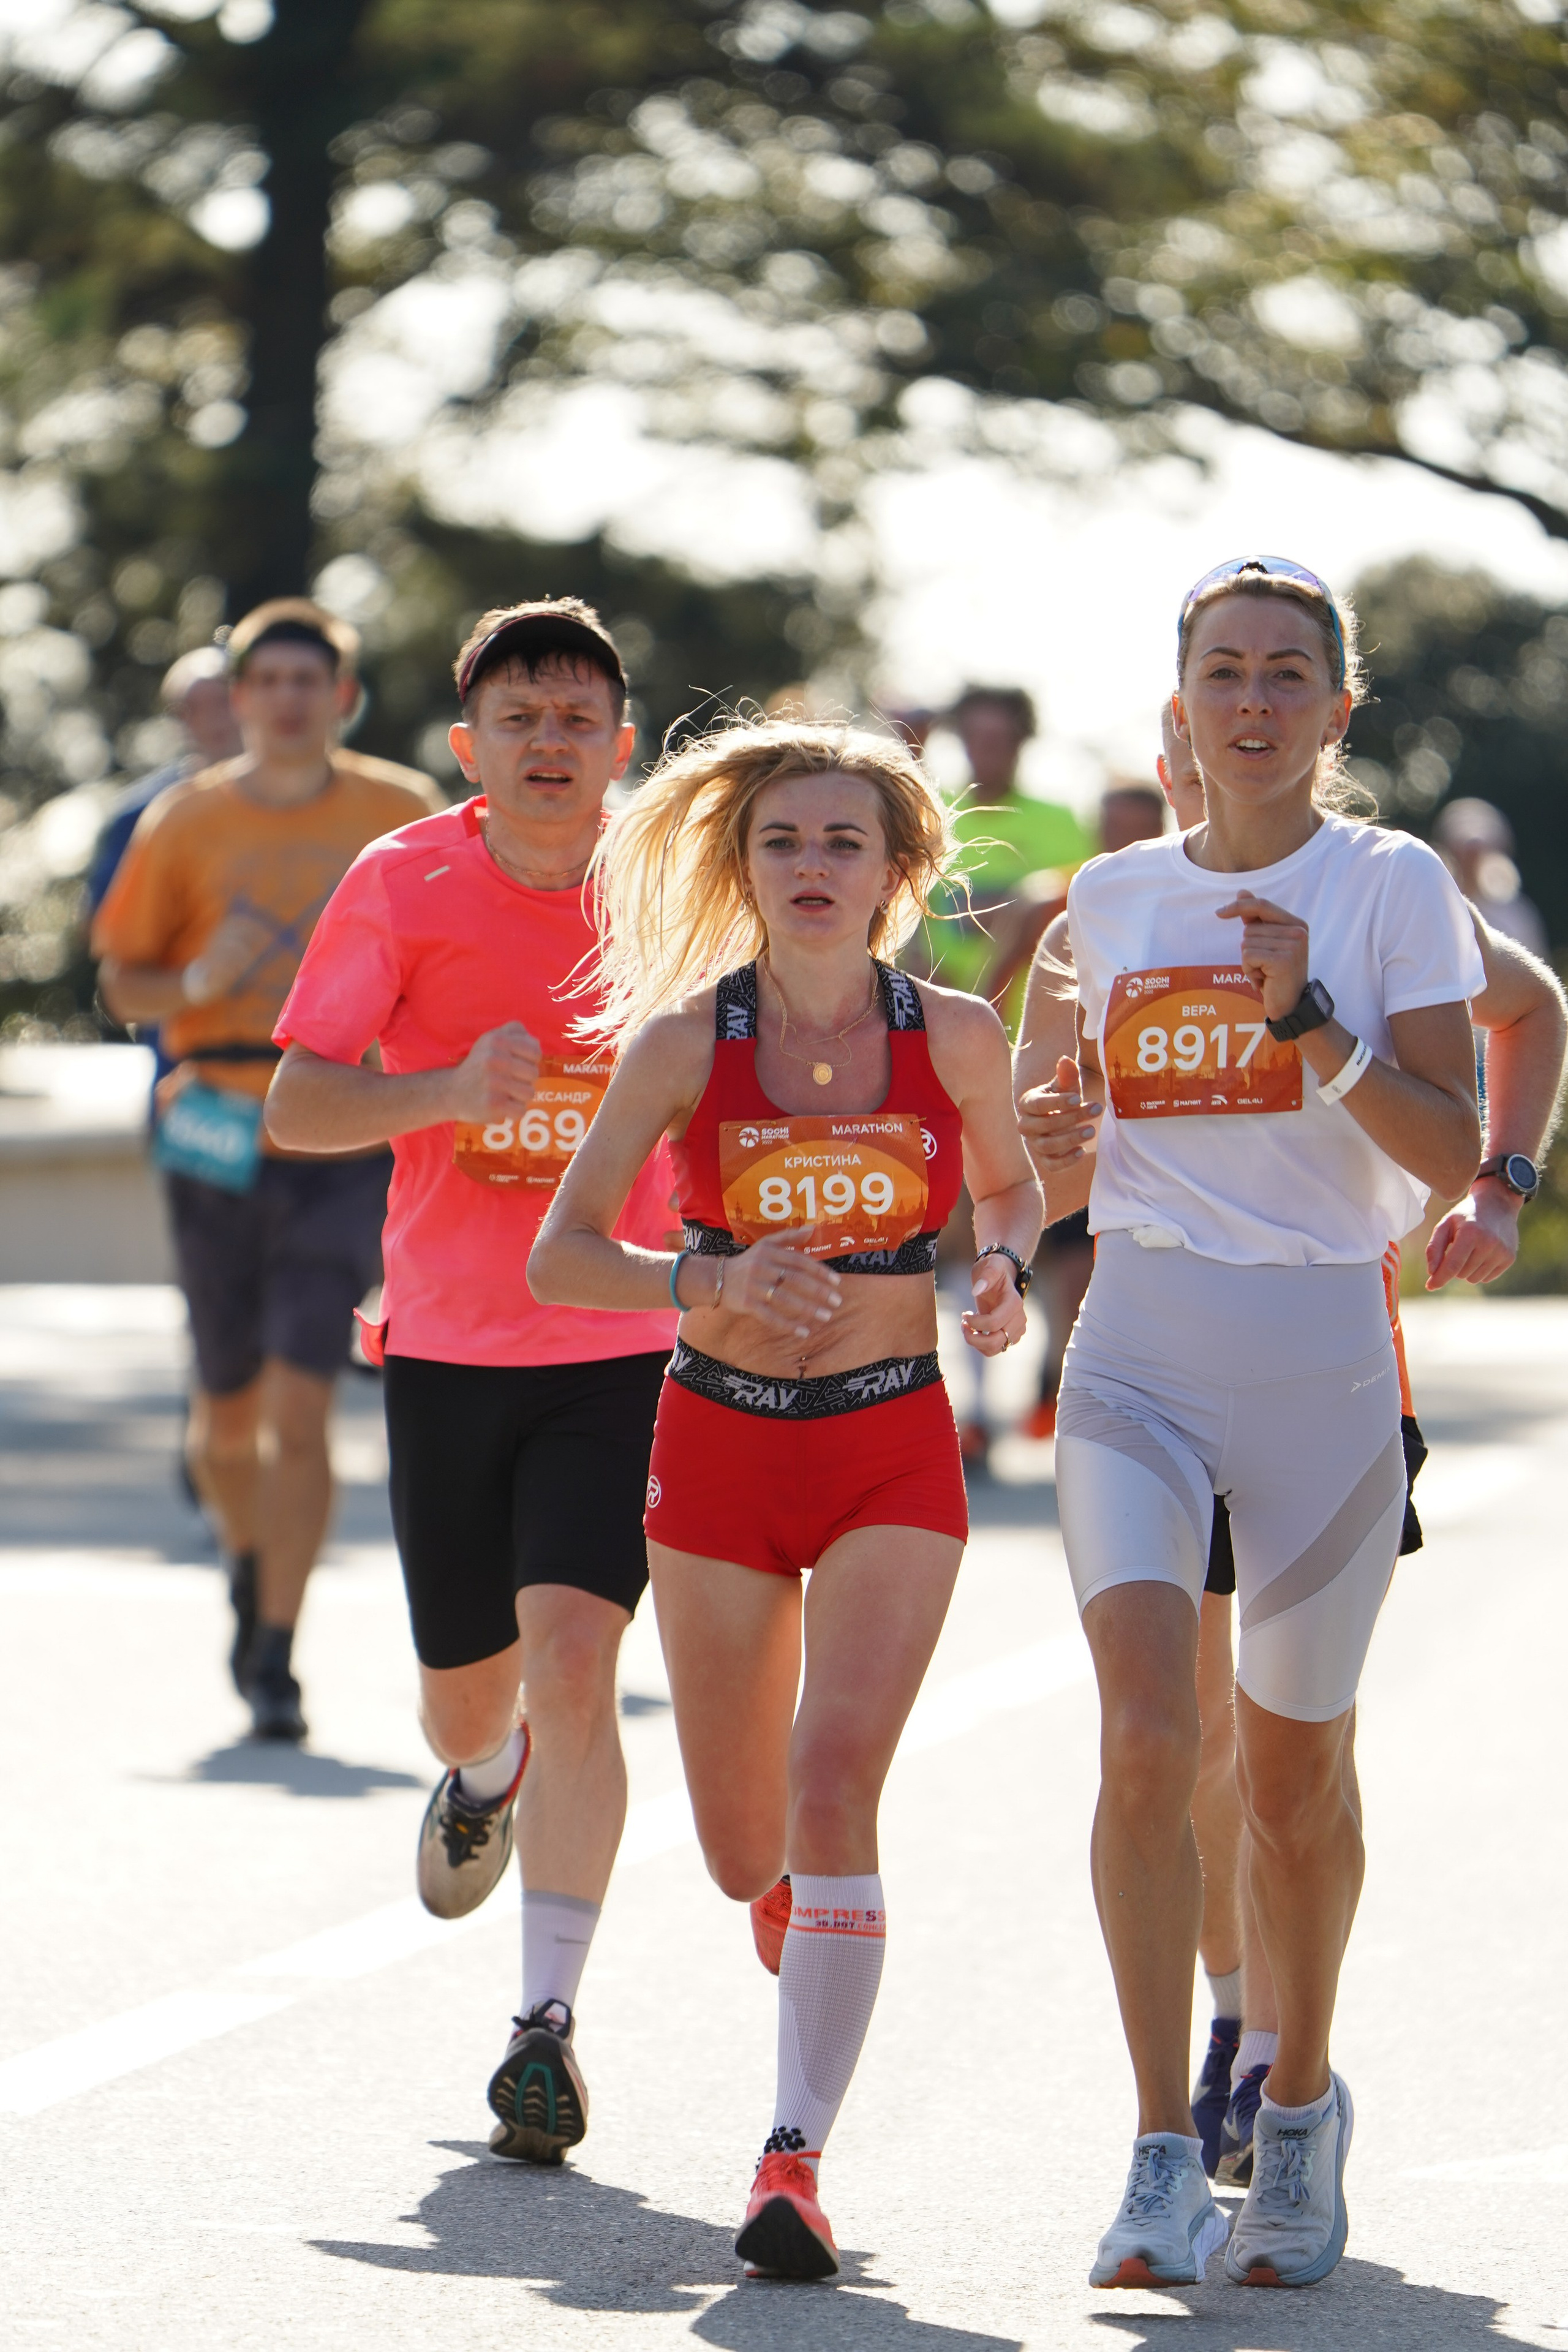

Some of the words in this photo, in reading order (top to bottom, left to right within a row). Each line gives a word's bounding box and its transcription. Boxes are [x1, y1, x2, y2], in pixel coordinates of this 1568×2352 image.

[1145, 976, 1169, 985] SOCHI
[1213, 973, 1251, 984] MARA
[1182, 1005, 1216, 1017] ВЕРА
[1137, 1023, 1266, 1072] 8917
[563, 1063, 613, 1074] MARATH
[533, 1091, 592, 1104] КСАНДР
[482, 1108, 586, 1152] 869
[832, 1123, 903, 1136] MARATHON
[784, 1154, 862, 1169] КРИСТИНА
[758, 1172, 894, 1221] 8199
[846, 1361, 915, 1400] RAY
[729, 1374, 799, 1410] RAY
